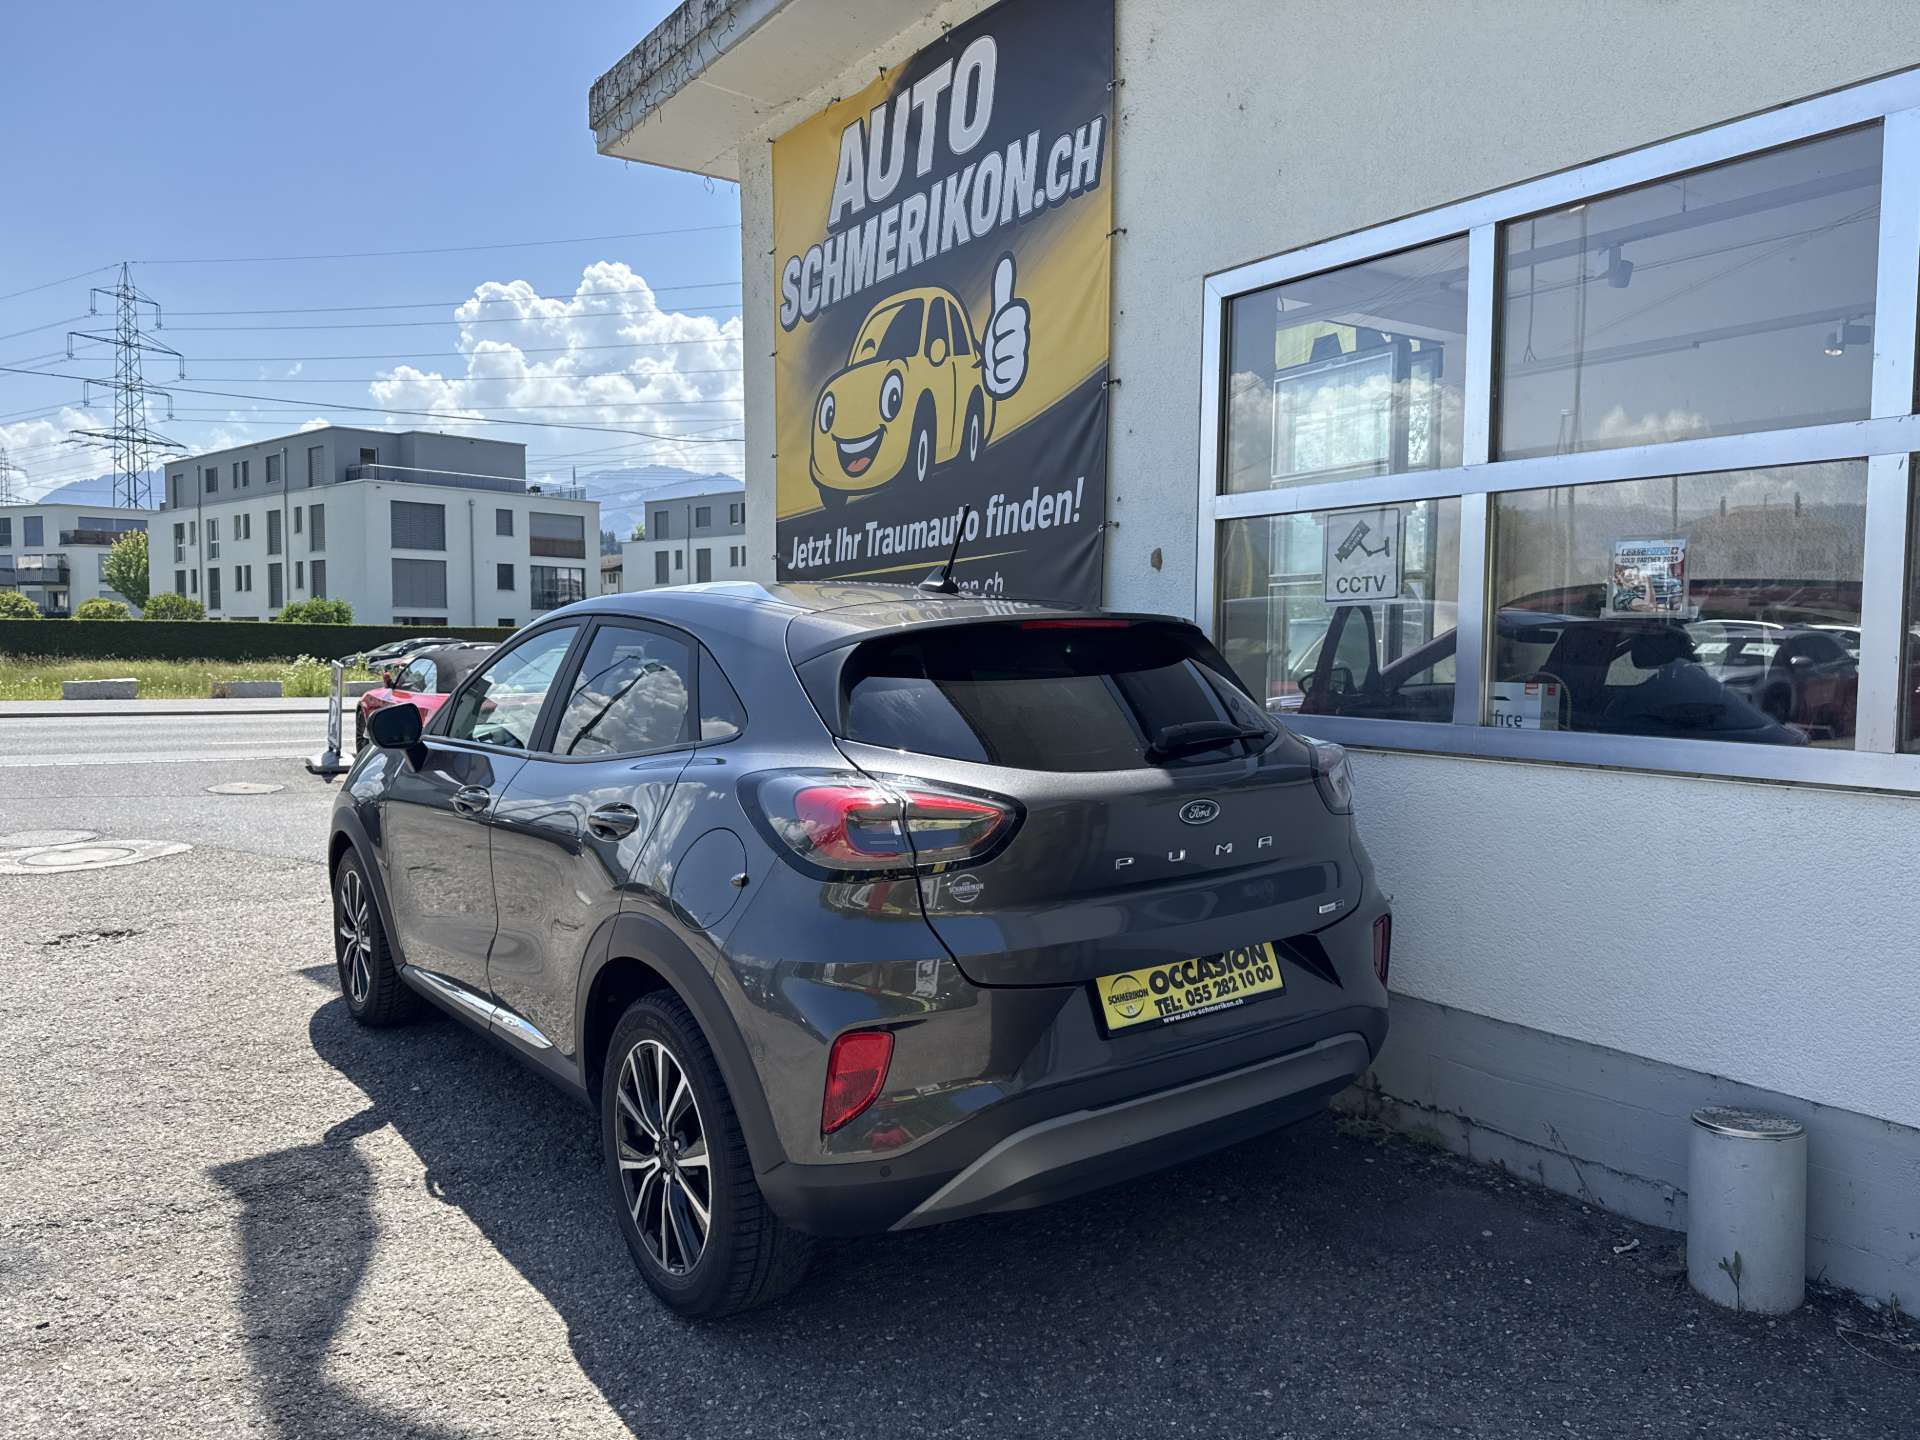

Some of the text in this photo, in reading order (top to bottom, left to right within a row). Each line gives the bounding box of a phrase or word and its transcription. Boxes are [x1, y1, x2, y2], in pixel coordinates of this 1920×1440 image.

[828, 35, 998, 228] AUTO
[780, 116, 1104, 328] SCHMERIKON.CH
[787, 476, 1085, 571] Jetzt Ihr Traumauto finden!
[1336, 574, 1387, 594] CCTV
[1148, 944, 1269, 995] OCCASION
[1153, 995, 1184, 1017] TEL:
[1185, 984, 1213, 1008] 055
[1213, 975, 1240, 999] 282
[1239, 970, 1255, 990] 10
[1255, 964, 1274, 981] 00
[1107, 987, 1149, 1005] SCHMERIKON
[1162, 998, 1245, 1024] www.auto-schmerikon.ch
